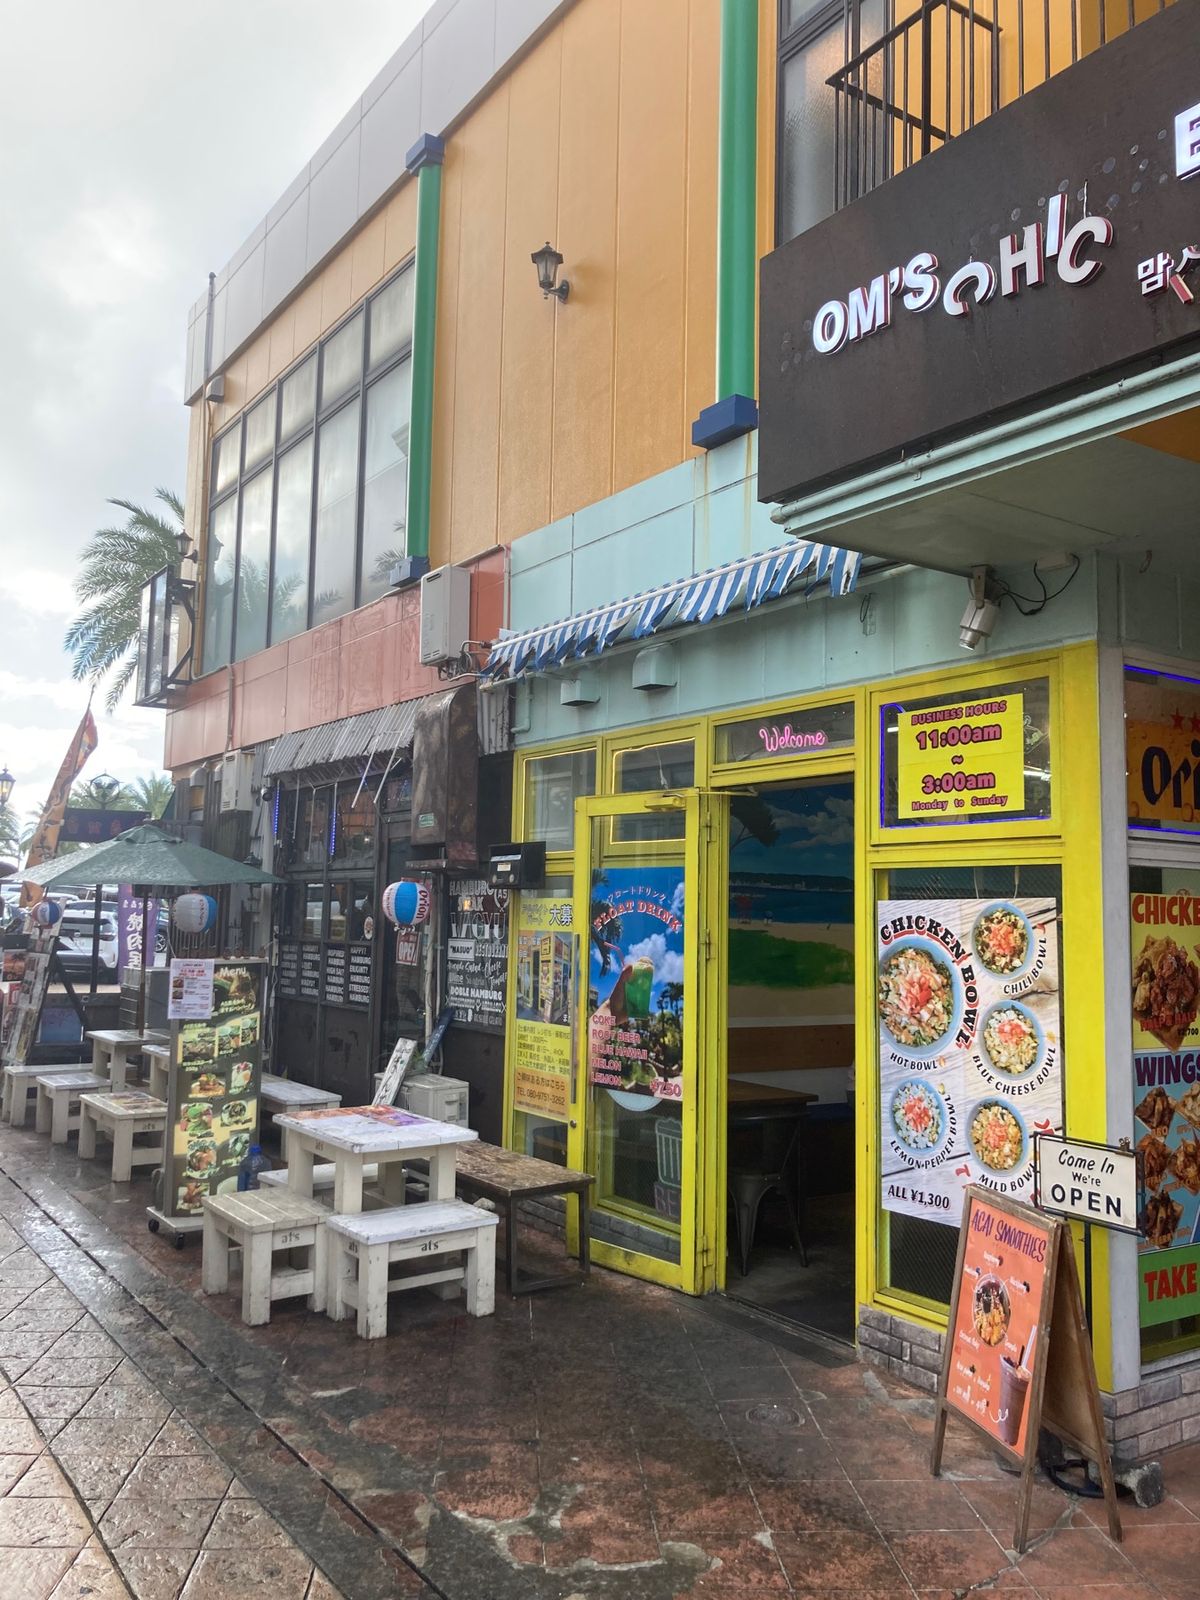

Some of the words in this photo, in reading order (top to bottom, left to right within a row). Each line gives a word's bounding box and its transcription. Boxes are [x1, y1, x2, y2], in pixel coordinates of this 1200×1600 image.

[911, 707, 963, 726] BUSINESS
[965, 700, 1007, 717] HOURS
[759, 724, 828, 752] Welcome
[916, 724, 1002, 750] 11:00am
[922, 771, 996, 795] 3:00am
[911, 799, 948, 811] Monday
[954, 798, 965, 807] to
[971, 794, 1008, 807] Sunday
[594, 900, 635, 931] FLOAT
[638, 901, 682, 933] DRINK
[220, 967, 246, 977] Menu
[1003, 976, 1033, 994] CHILI
[1031, 938, 1047, 979] BOWL
[470, 988, 502, 1001] HAMBURG
[880, 915, 973, 965] CHICKEN
[956, 965, 979, 1049] BOWL
[592, 1015, 616, 1026] COKE
[592, 1029, 615, 1041] ROOT
[617, 1031, 641, 1044] BEER
[592, 1058, 621, 1071] MELON
[615, 1046, 647, 1060] HAWAII
[890, 1052, 909, 1068] HOT
[910, 1061, 938, 1071] BOWL
[591, 1072, 622, 1086] LEMON
[972, 1055, 995, 1085] BLUE
[995, 1080, 1037, 1096] CHEESE
[1036, 1047, 1057, 1086] BOWL
[650, 1079, 682, 1097] ¥750
[945, 1095, 958, 1136] BOWL
[1058, 1149, 1096, 1171] Come
[1100, 1157, 1115, 1175] In
[979, 1174, 1008, 1192] MILD
[1072, 1171, 1102, 1187] We're
[888, 1184, 907, 1199] ALL
[911, 1189, 950, 1210] ¥1,300
[1051, 1183, 1121, 1218] OPEN
[972, 1209, 994, 1237] ACAI
[995, 1219, 1047, 1263] SMOOTHIES
[1144, 1263, 1198, 1302] TAKE
